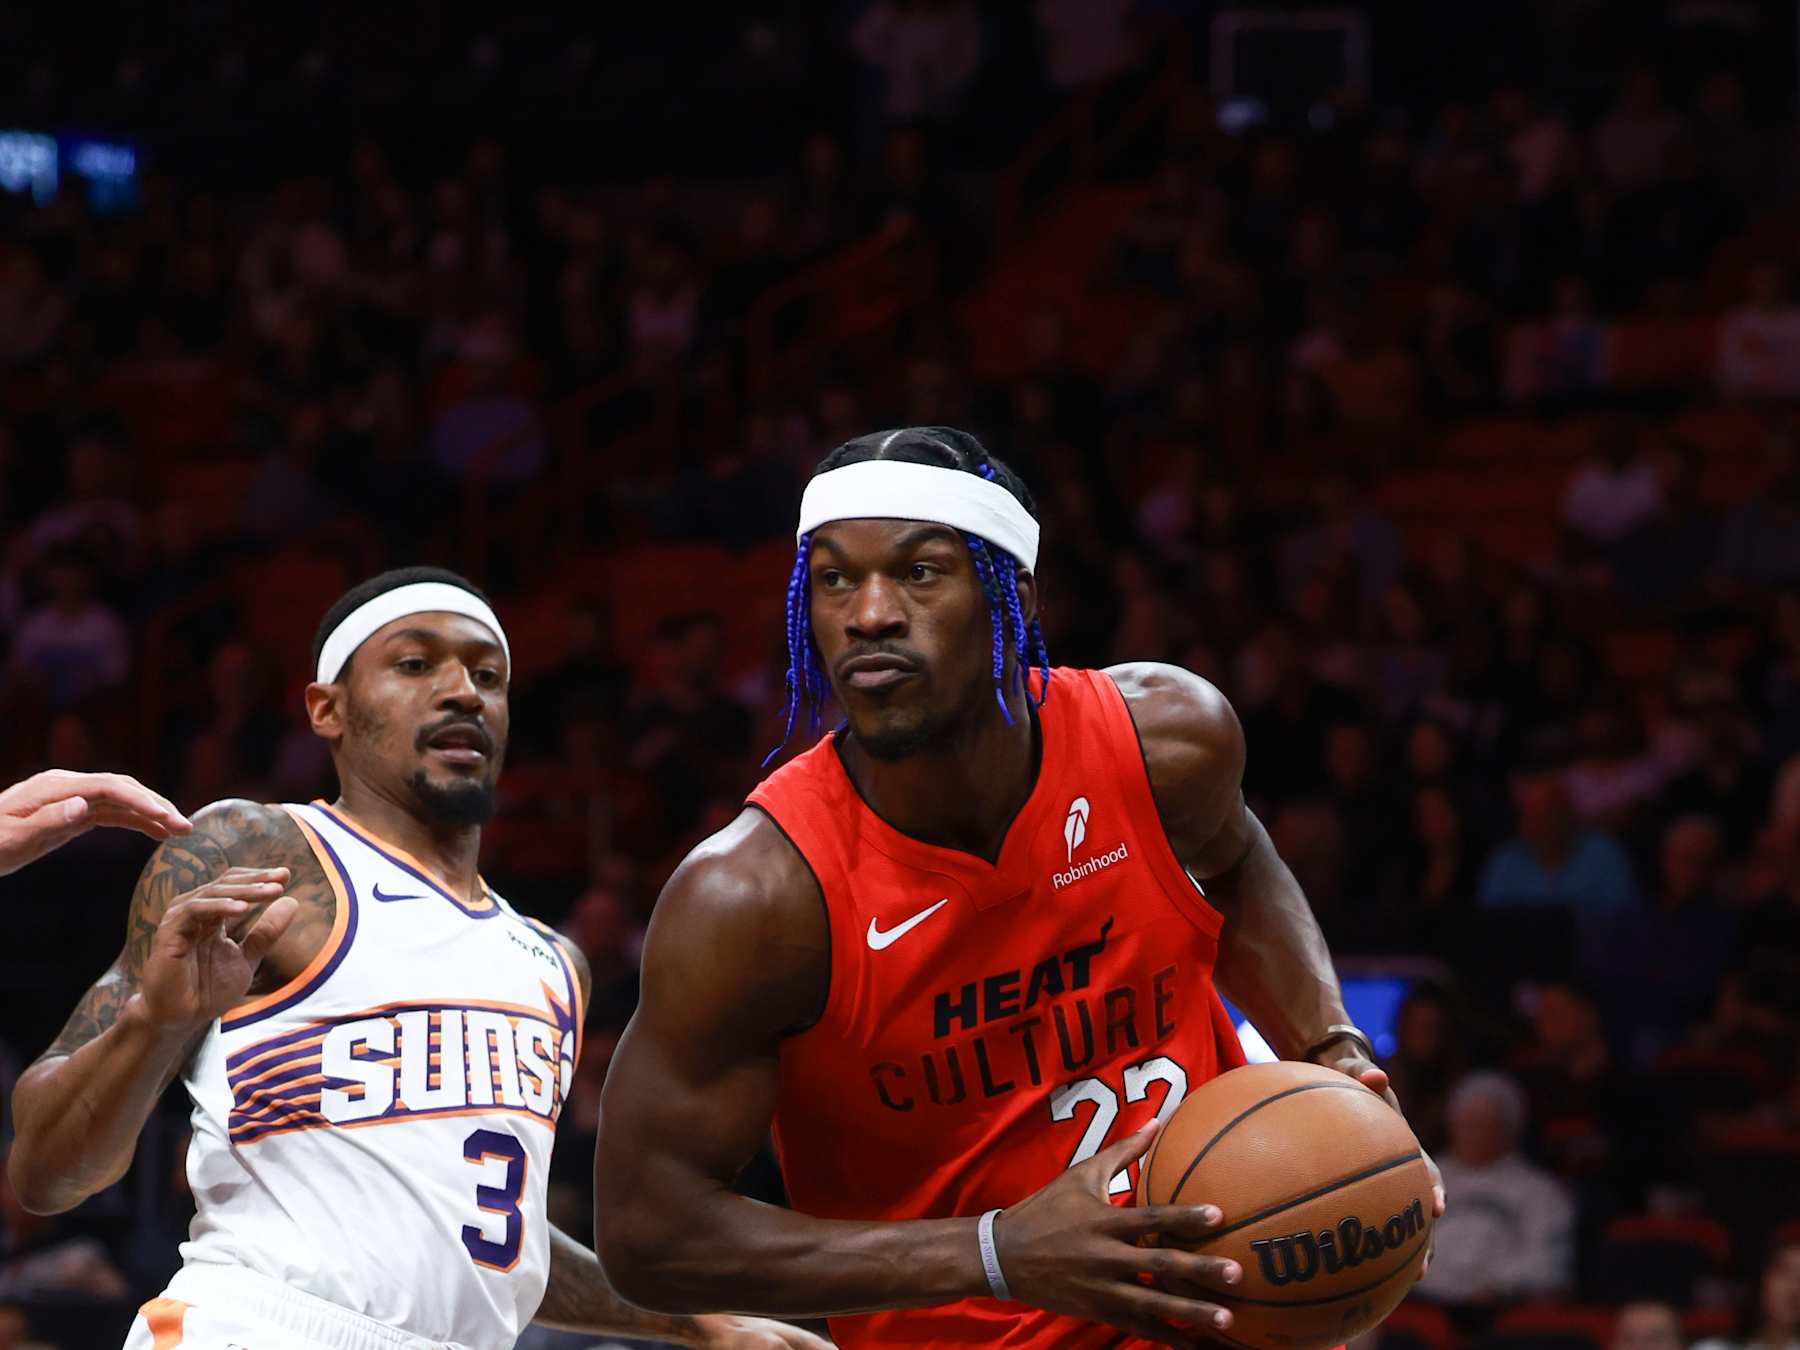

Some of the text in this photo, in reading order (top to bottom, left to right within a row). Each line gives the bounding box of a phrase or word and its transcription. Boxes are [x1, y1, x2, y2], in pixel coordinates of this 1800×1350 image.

[1052, 842, 1129, 889] Robinhood
[870, 964, 1179, 1112] CULTURE
[933, 914, 1114, 1039] HEAT
[320, 1009, 555, 1124] SUNS
[1049, 1056, 1188, 1196] 22
[462, 1128, 528, 1274] 3
[1250, 1199, 1425, 1287] Wilson
